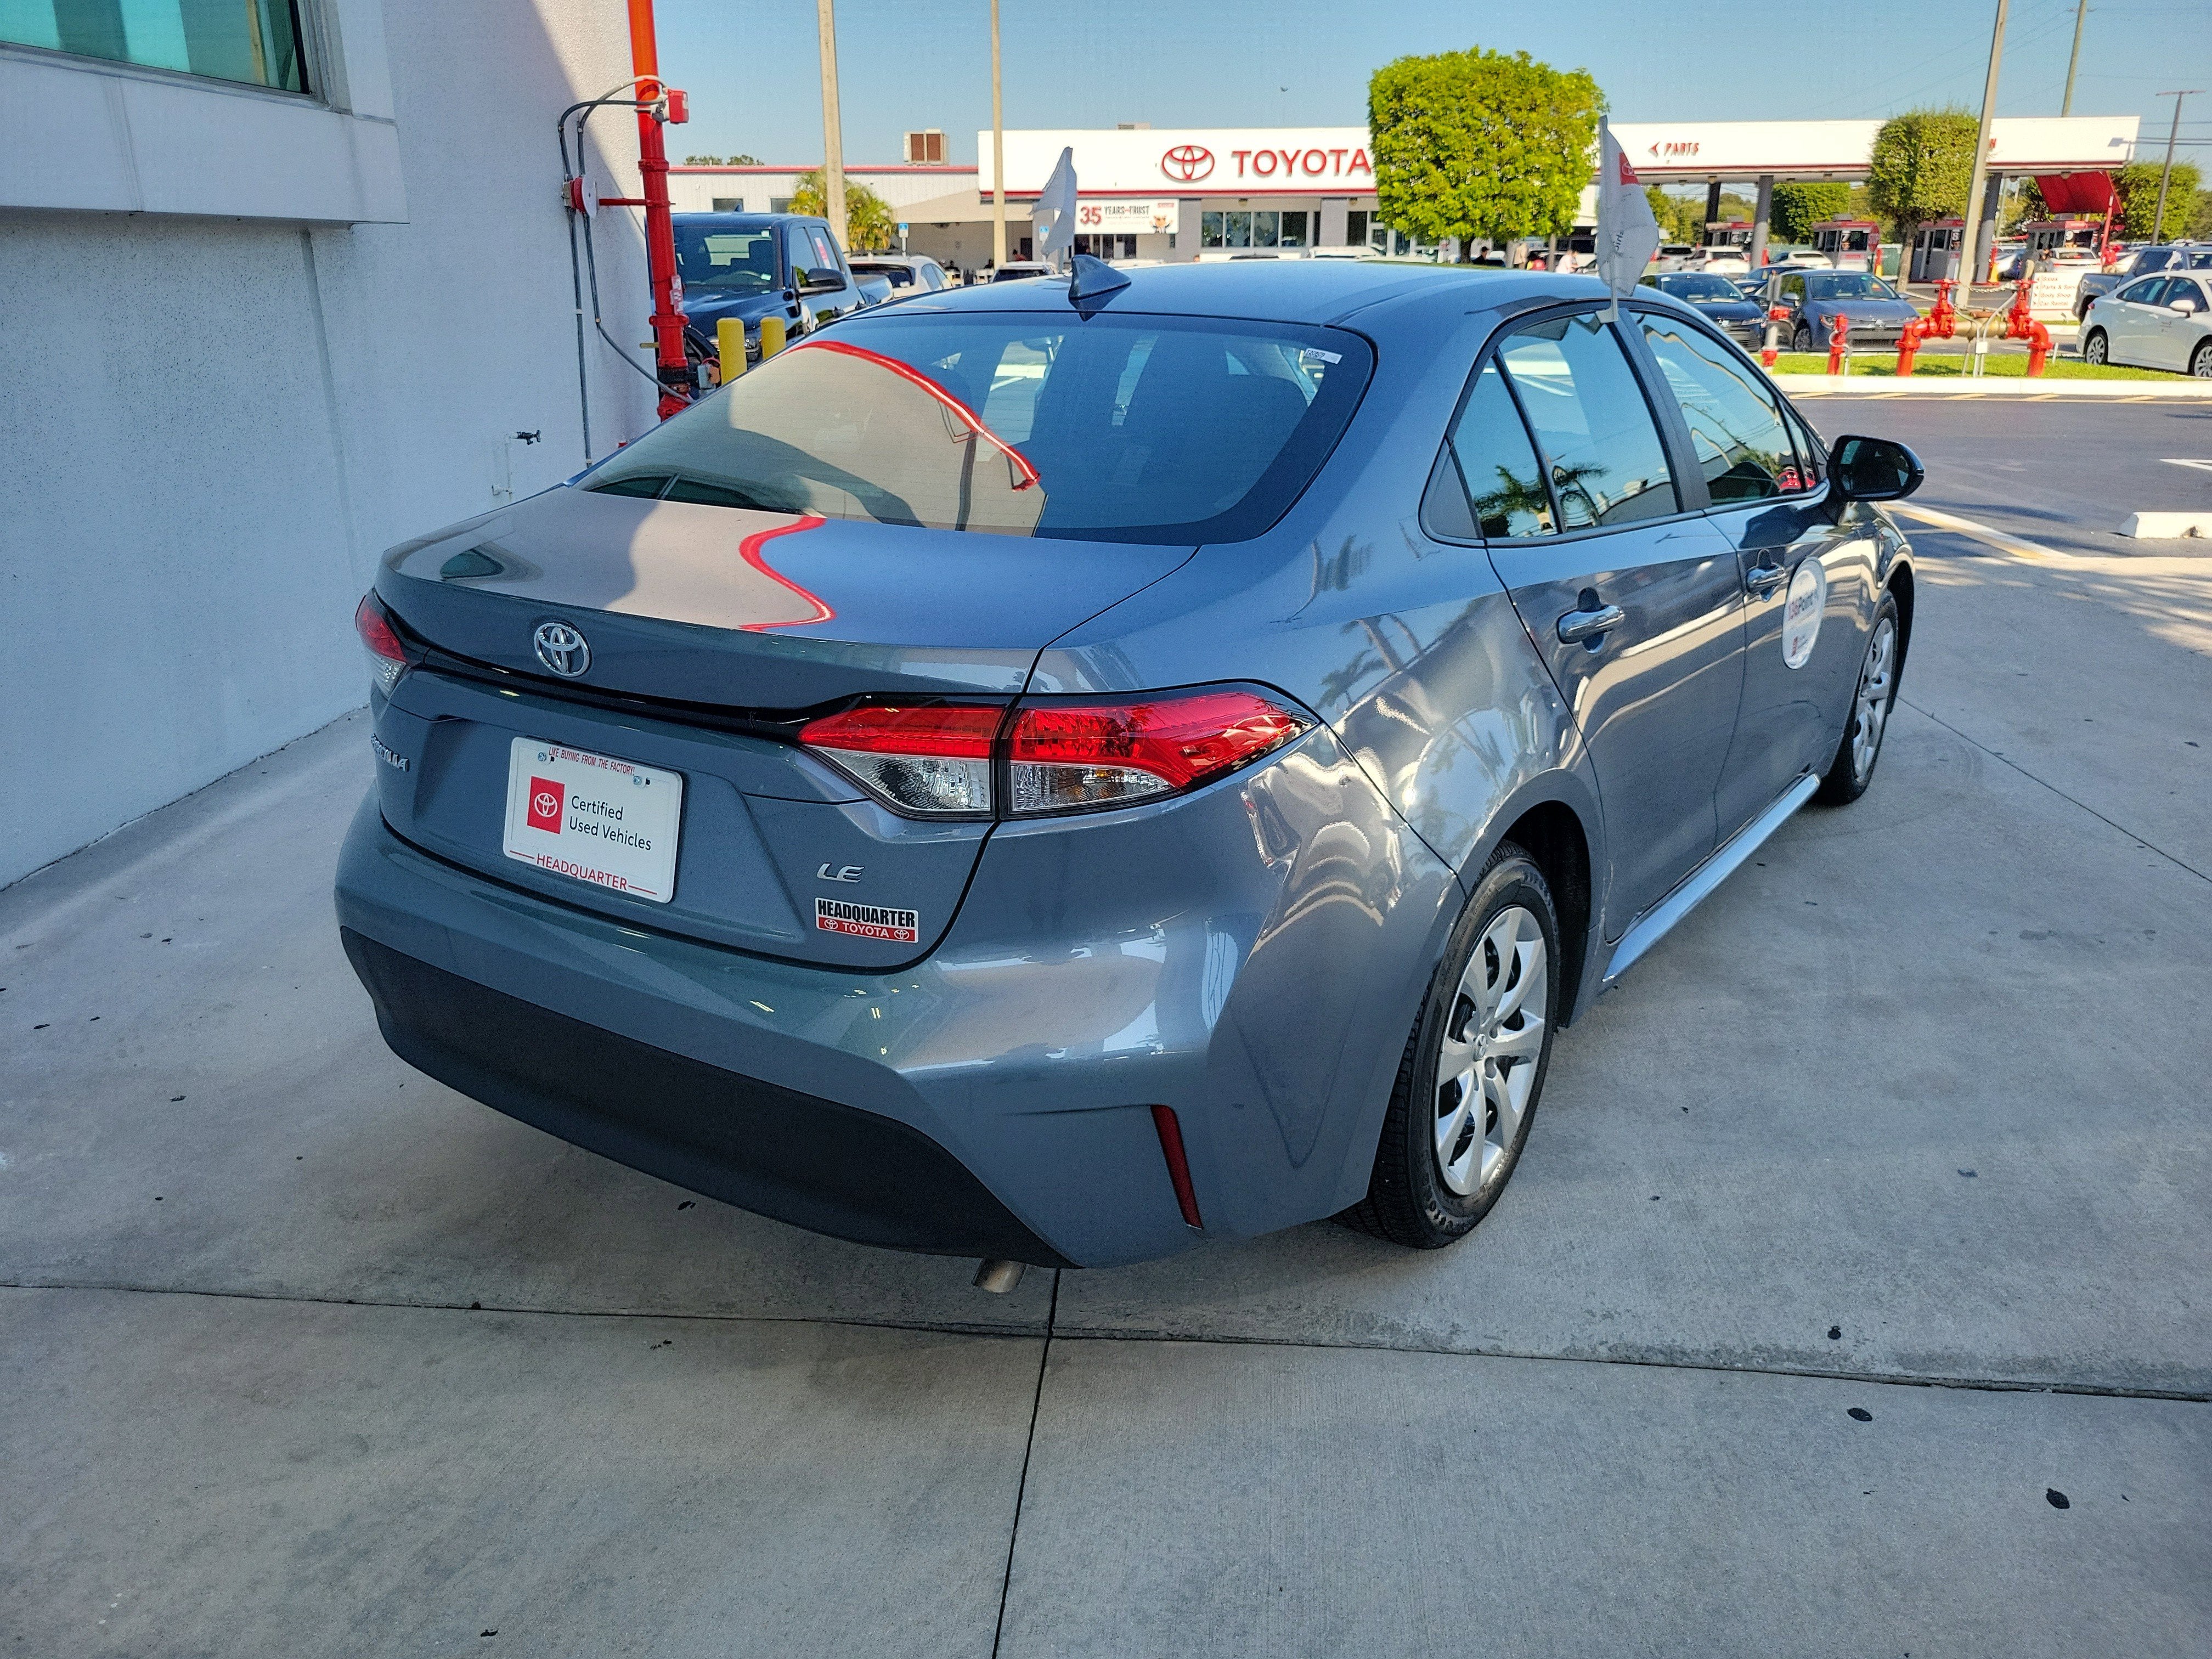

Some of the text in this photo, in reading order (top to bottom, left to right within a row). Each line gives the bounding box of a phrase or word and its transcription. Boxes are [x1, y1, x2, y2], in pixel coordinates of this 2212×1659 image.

[1664, 143, 1699, 154] PARTS
[1231, 149, 1372, 176] TOYOTA
[1080, 206, 1102, 225] 35
[1104, 206, 1125, 215] YEARS
[2066, 230, 2074, 240] 9
[549, 747, 635, 775] LIKE BUYING FROM THE FACTORY!
[571, 795, 624, 821] Certified
[569, 816, 652, 851] Used Vehicles
[537, 853, 628, 890] HEADQUARTER
[817, 862, 865, 883] LE
[818, 899, 915, 928] HEADQUARTER
[842, 922, 889, 938] TOYOTA
